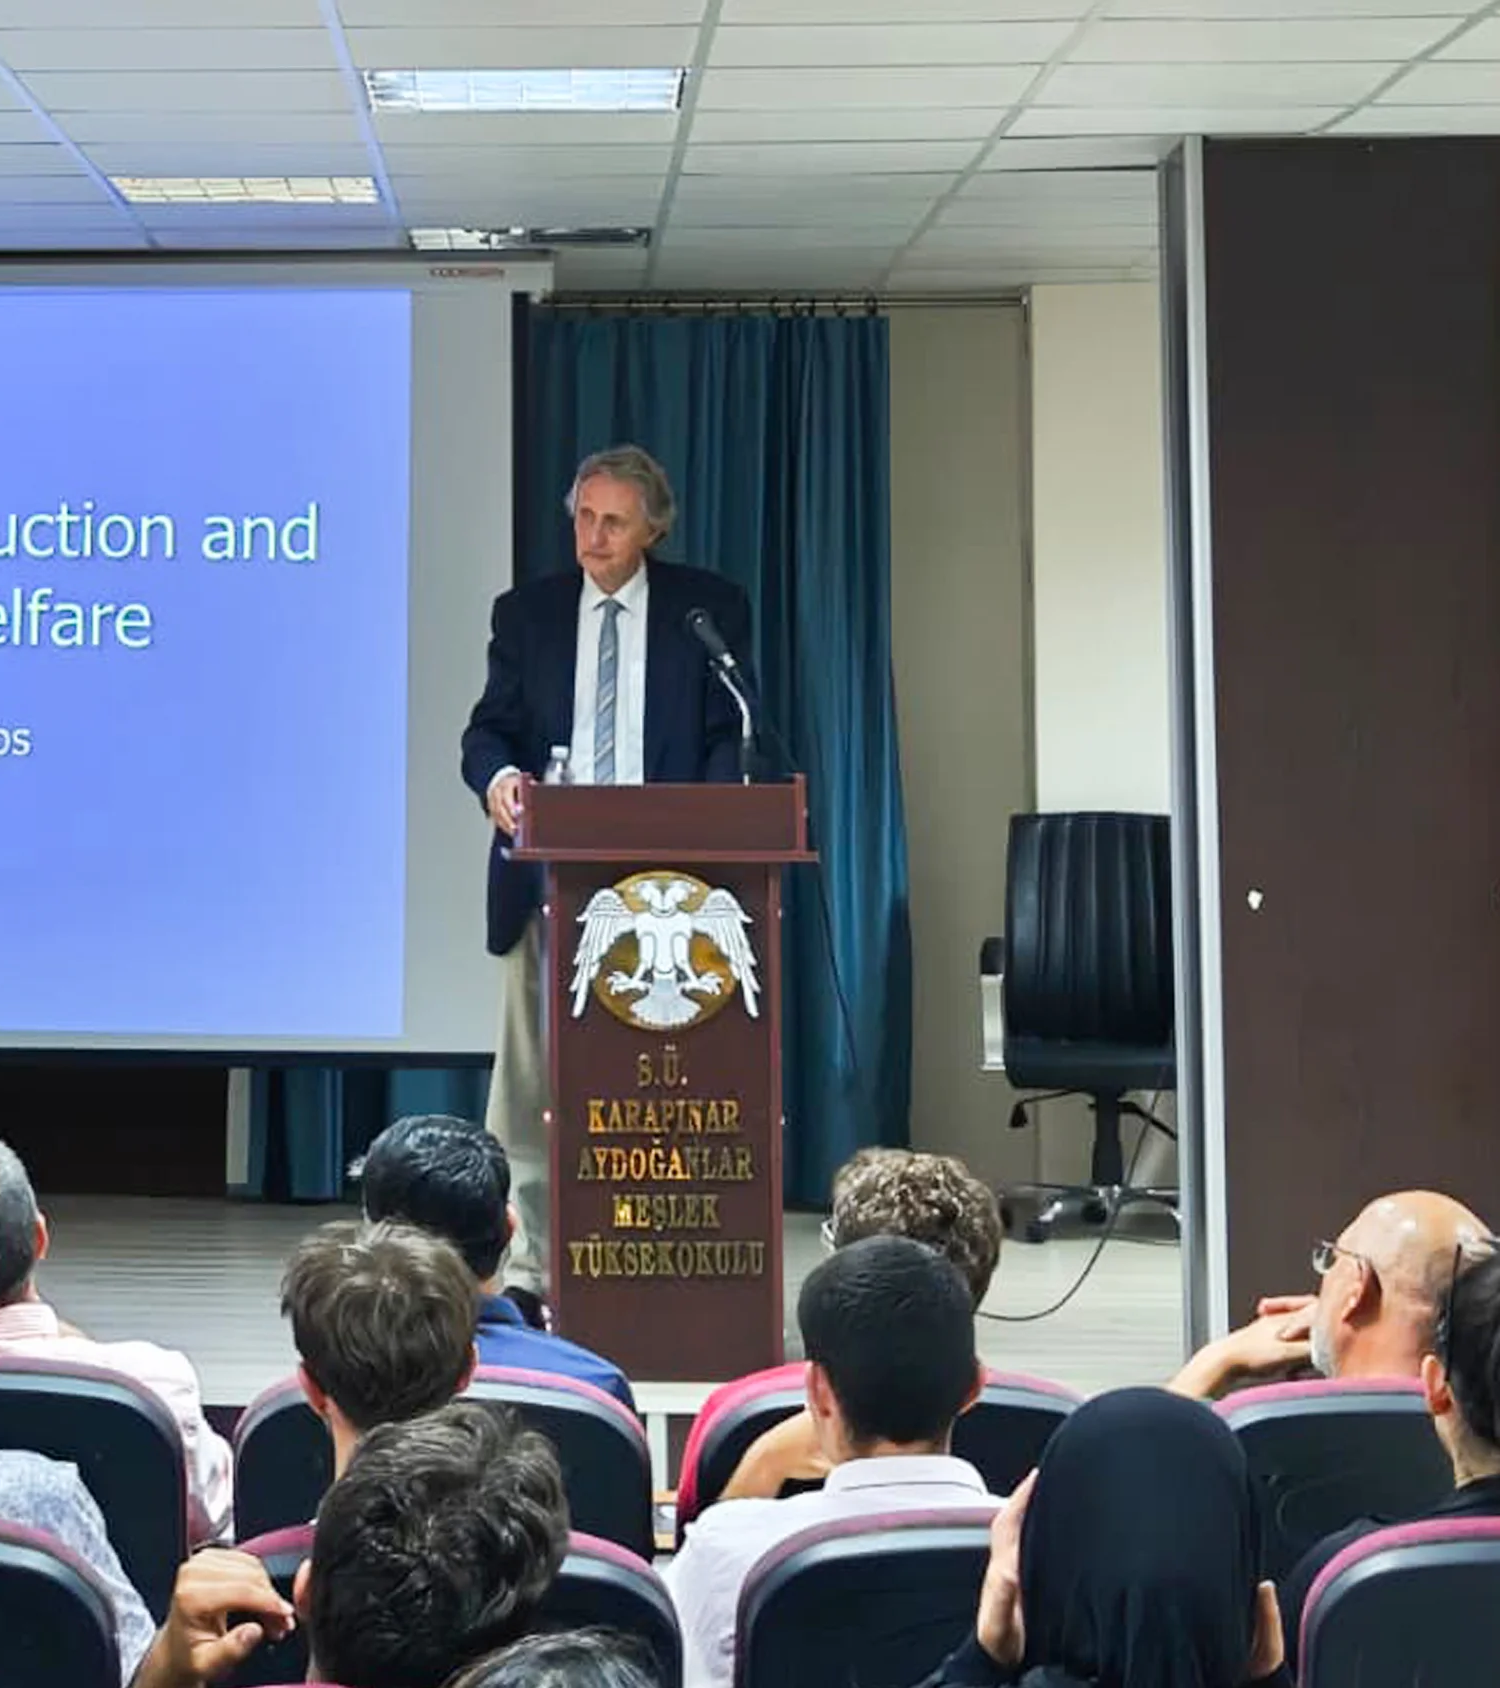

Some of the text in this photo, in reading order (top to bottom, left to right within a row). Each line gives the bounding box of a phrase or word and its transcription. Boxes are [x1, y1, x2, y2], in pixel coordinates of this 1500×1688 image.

[201, 501, 318, 561] and
[637, 1044, 688, 1088] S.Ü.
[588, 1100, 740, 1134] KARAPINAR
[577, 1137, 753, 1181] AYDOĞANLAR
[568, 1234, 765, 1278] YÜKSEKOKULU
